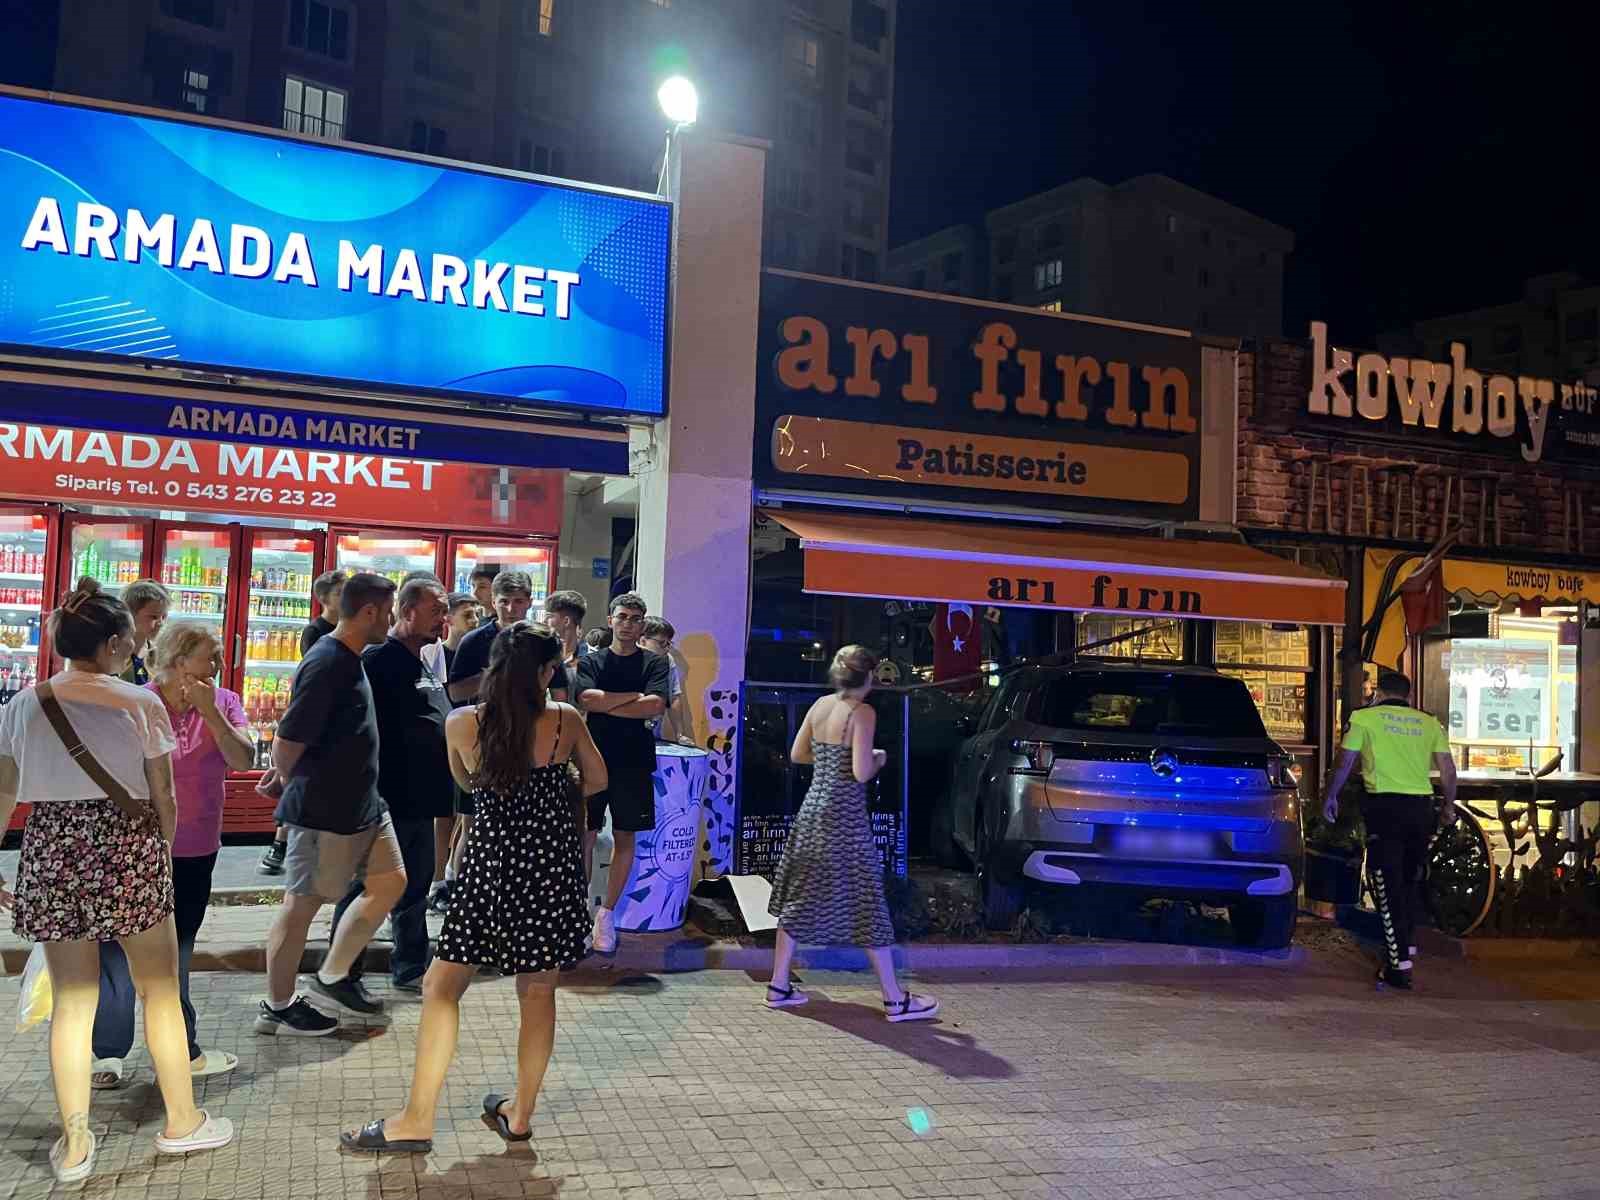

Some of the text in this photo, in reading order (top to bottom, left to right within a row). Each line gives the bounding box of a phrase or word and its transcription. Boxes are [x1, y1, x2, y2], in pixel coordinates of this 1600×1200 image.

[21, 197, 580, 319] ARMADA MARKET
[774, 315, 1197, 433] arı fırın
[1308, 321, 1554, 462] kowboy
[168, 405, 421, 451] ARMADA MARKET
[217, 443, 444, 491] MARKET
[896, 439, 1087, 486] Patisserie
[55, 473, 337, 508] Sipariş Tel. 0 543 276 23 22
[987, 575, 1203, 613] arı fırın
[1506, 566, 1550, 592] kowboy
